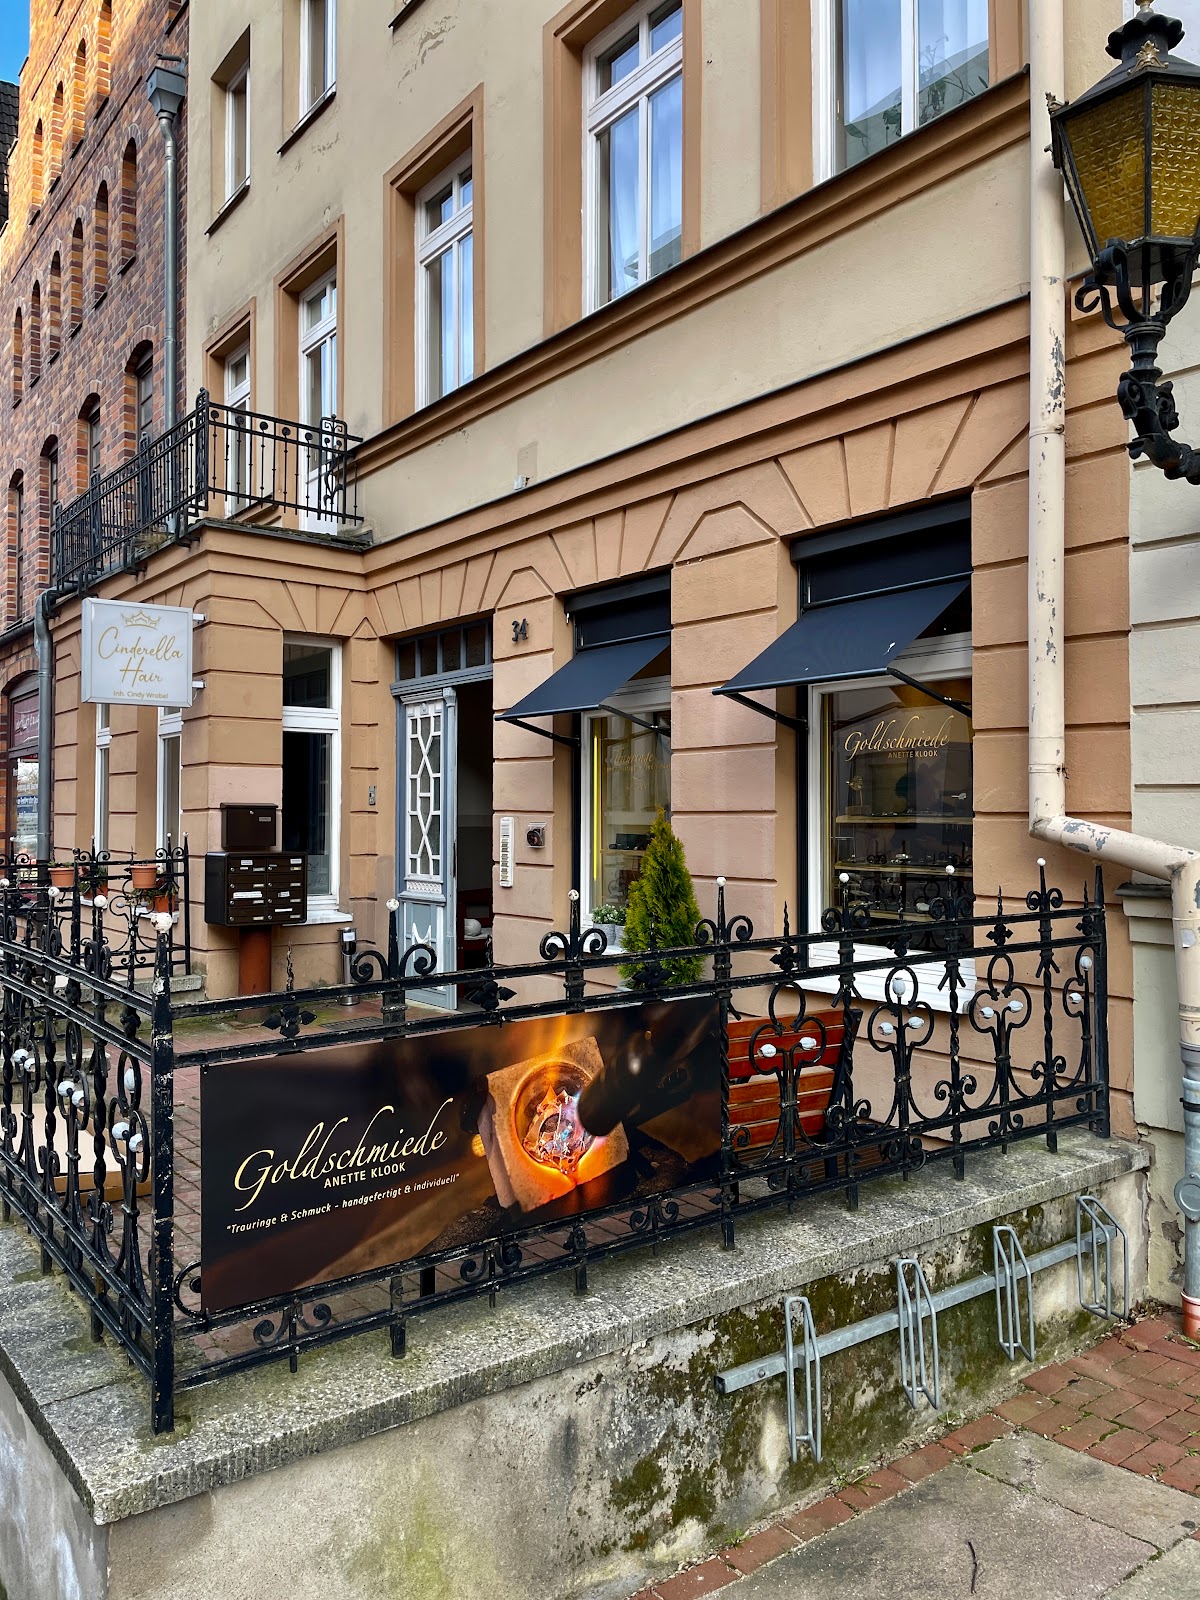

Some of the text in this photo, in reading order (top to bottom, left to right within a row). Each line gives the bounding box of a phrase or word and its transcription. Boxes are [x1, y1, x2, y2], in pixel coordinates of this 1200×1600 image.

[98, 626, 184, 661] Cinderella
[511, 618, 529, 642] 34
[119, 656, 161, 688] Hair
[127, 691, 145, 699] Cindy
[844, 715, 955, 762] Goldschmiede
[888, 749, 938, 759] ANETTE KLOOK
[234, 1097, 454, 1212] Goldschmiede
[323, 1161, 406, 1189] ANETTE KLOOK
[226, 1217, 277, 1234] "Trauringe
[280, 1213, 289, 1223] &
[290, 1202, 332, 1221] Schmuck
[342, 1188, 402, 1209] handgefertigt
[404, 1184, 411, 1195] &
[413, 1172, 460, 1192] individuell"
